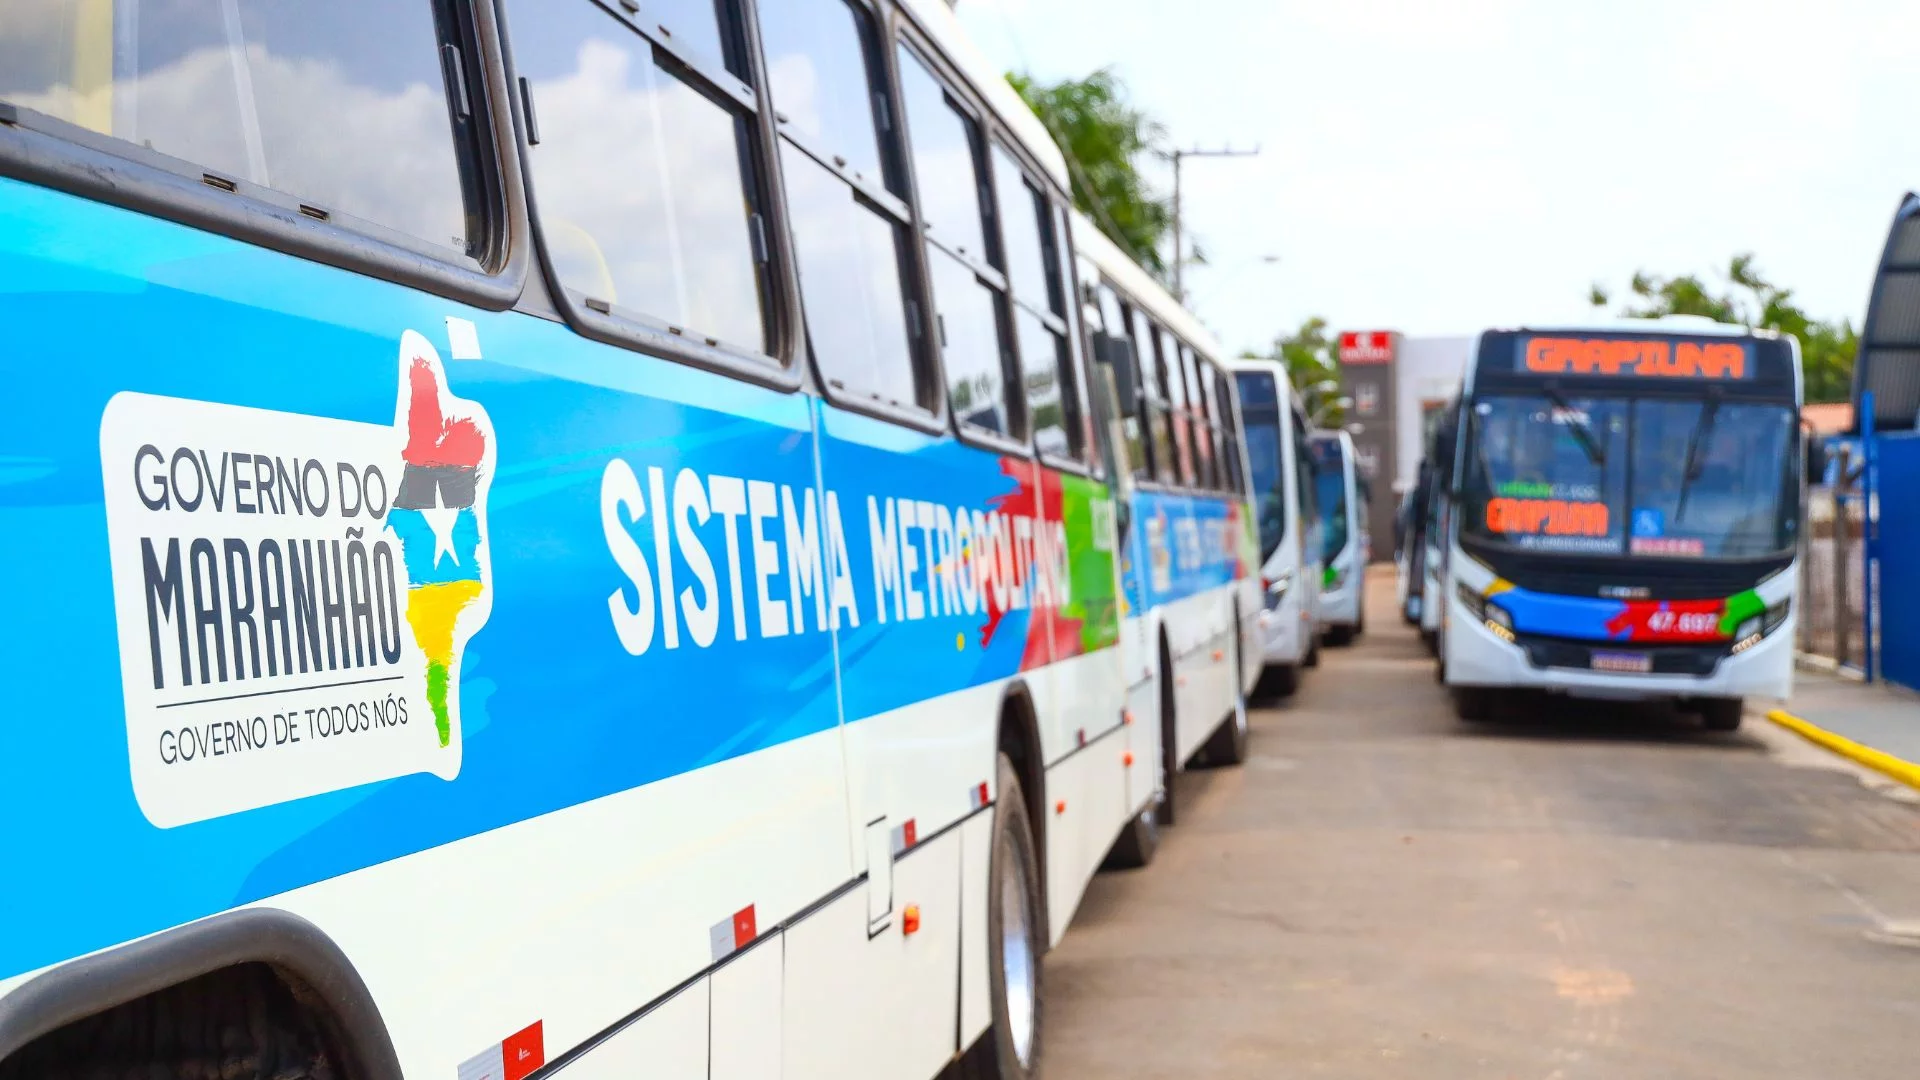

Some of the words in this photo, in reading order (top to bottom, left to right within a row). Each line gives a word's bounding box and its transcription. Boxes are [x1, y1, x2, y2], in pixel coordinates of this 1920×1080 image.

[1526, 337, 1745, 380] GRAPIUNA
[134, 444, 330, 518] GOVERNO
[337, 462, 387, 520] DO
[601, 458, 860, 656] SISTEMA
[867, 495, 1071, 624] METROPOLITANO
[140, 526, 402, 690] MARANHÃO
[159, 717, 267, 765] GOVERNO
[274, 711, 300, 746] DE
[305, 702, 369, 740] TODOS
[372, 692, 408, 729] NÓS
